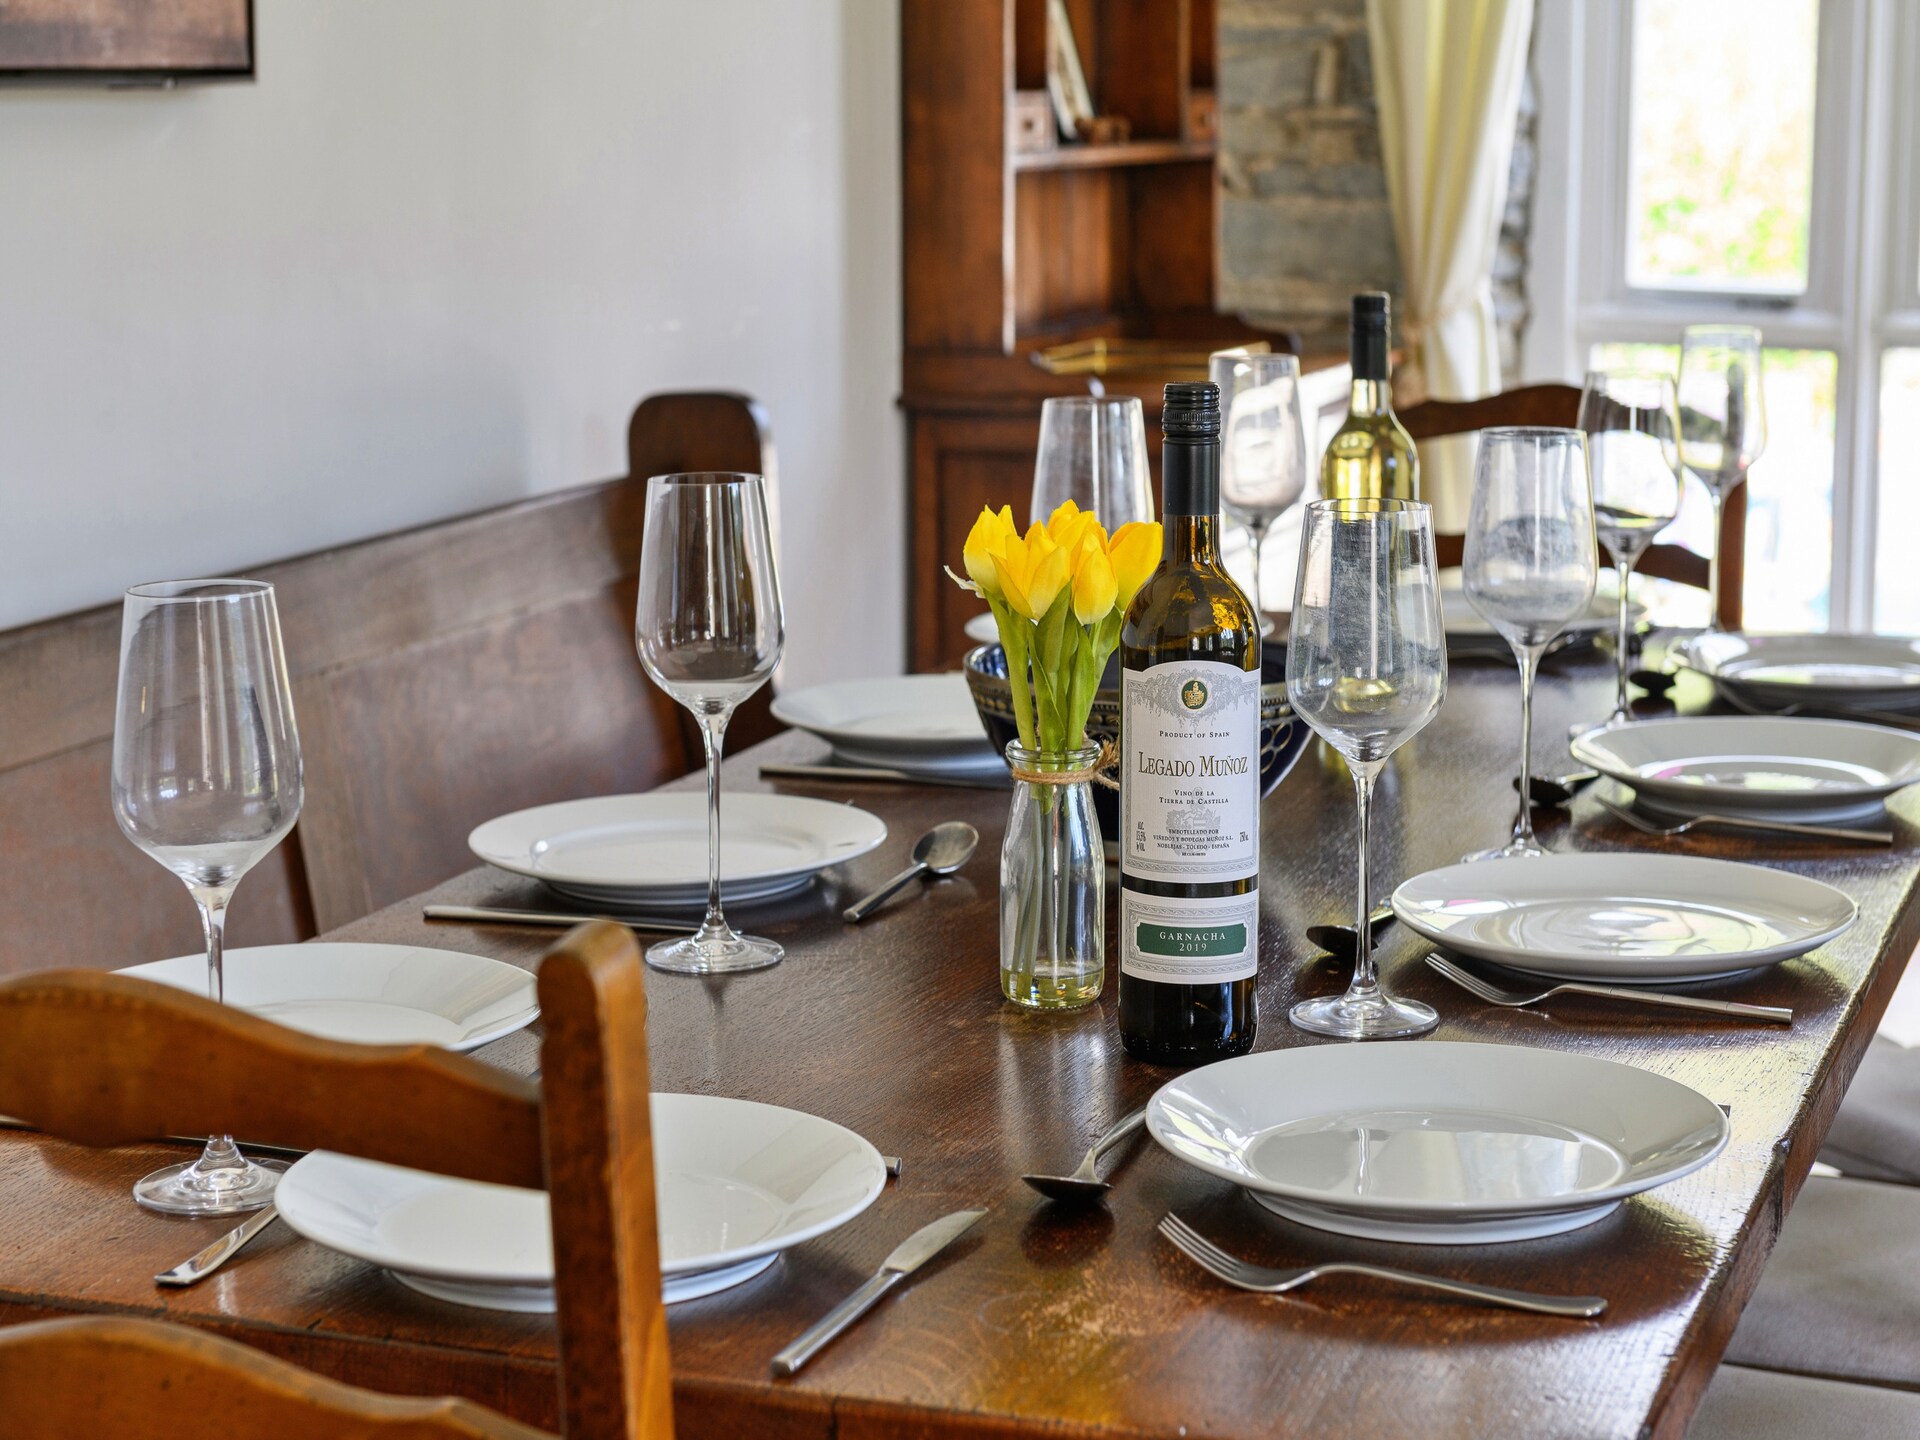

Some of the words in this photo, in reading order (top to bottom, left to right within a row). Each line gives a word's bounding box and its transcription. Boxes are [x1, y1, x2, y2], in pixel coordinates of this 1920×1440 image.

[1159, 730, 1193, 738] PRODUCT
[1138, 752, 1195, 778] LEGADO
[1198, 755, 1248, 777] MUÑOZ
[1160, 932, 1226, 940] GARNACHA
[1180, 943, 1206, 952] 2019
